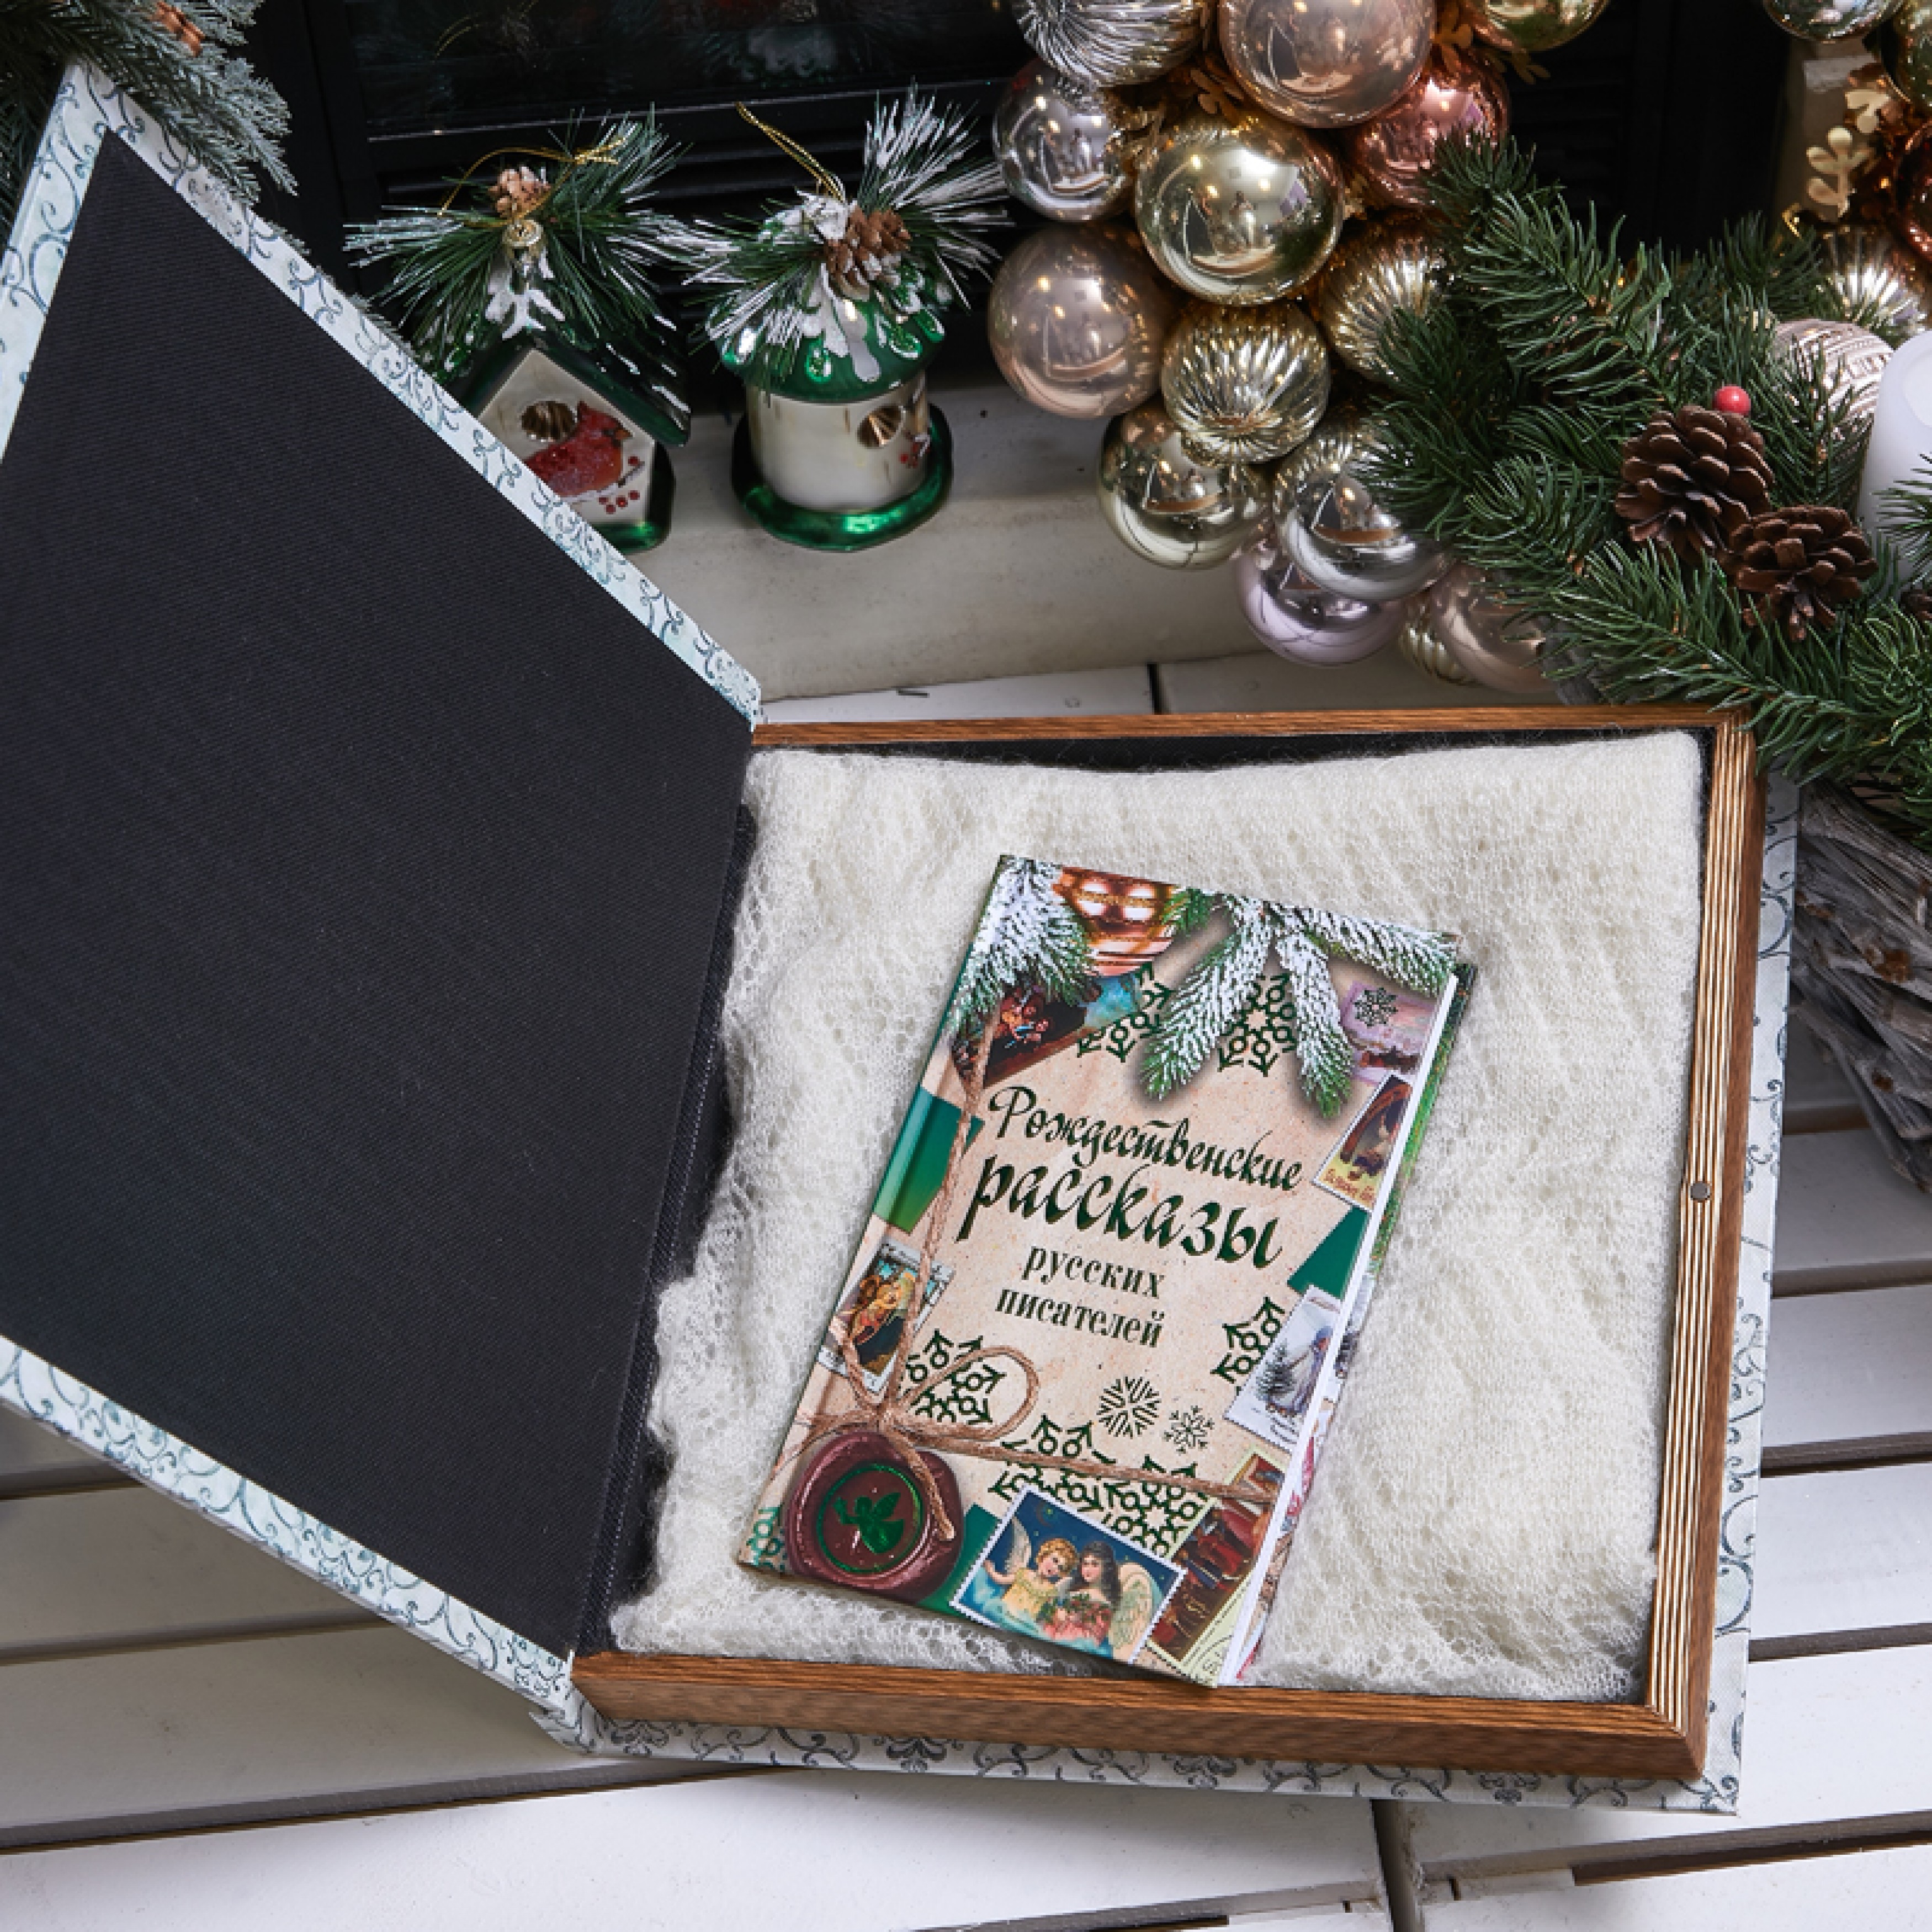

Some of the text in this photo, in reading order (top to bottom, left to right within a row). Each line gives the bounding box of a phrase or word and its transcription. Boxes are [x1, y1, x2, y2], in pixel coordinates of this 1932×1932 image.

[989, 1086, 1303, 1191] Рождественские
[956, 1155, 1283, 1268] рассказы
[1022, 1246, 1164, 1298] русских
[996, 1289, 1164, 1347] писателей
